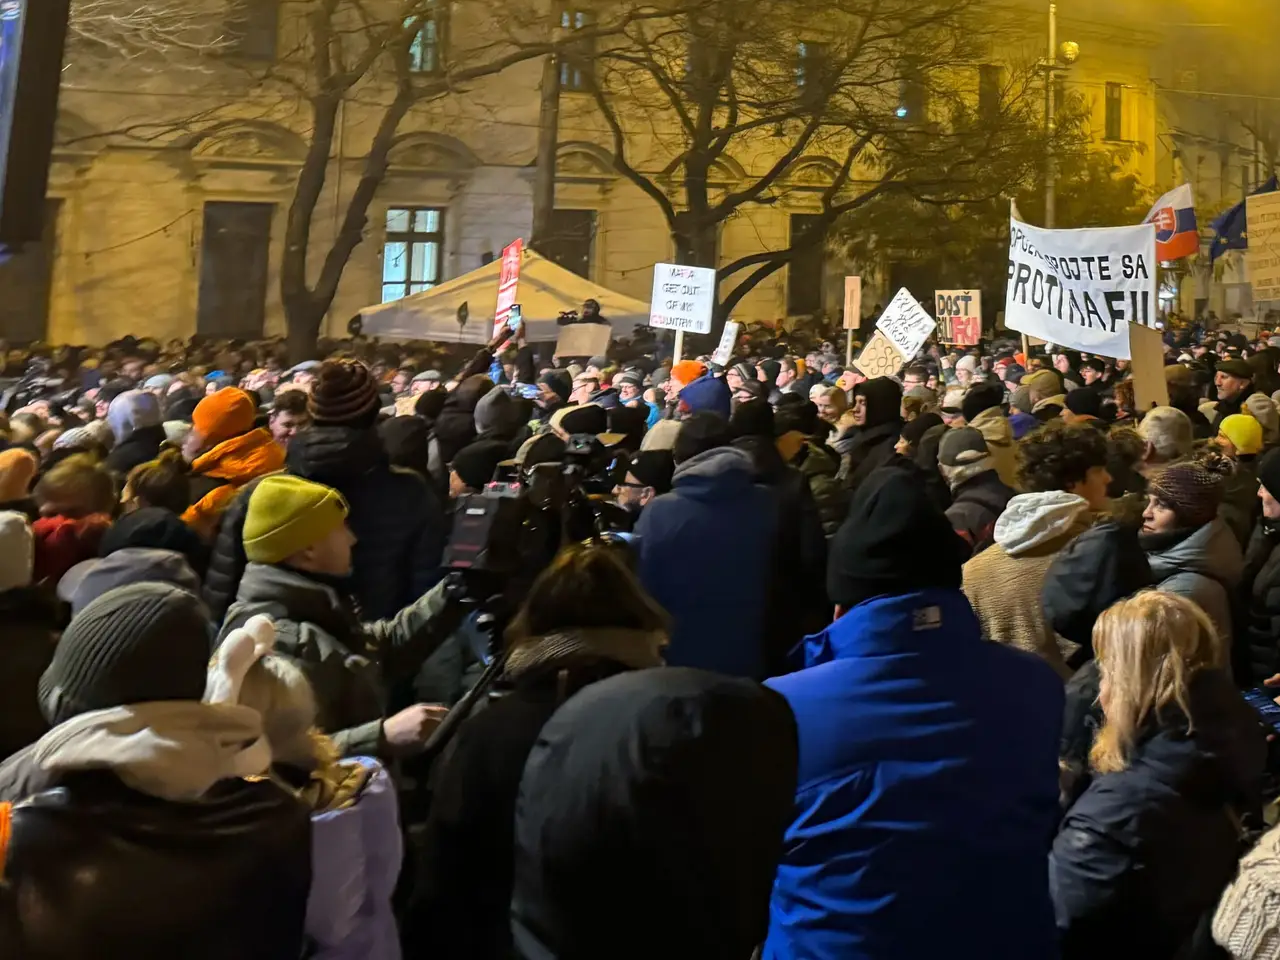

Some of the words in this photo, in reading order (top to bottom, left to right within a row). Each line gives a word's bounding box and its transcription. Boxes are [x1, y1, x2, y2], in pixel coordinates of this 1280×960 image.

[1122, 254, 1149, 280] SA
[681, 285, 701, 296] OUT
[937, 291, 973, 316] DOSŤ
